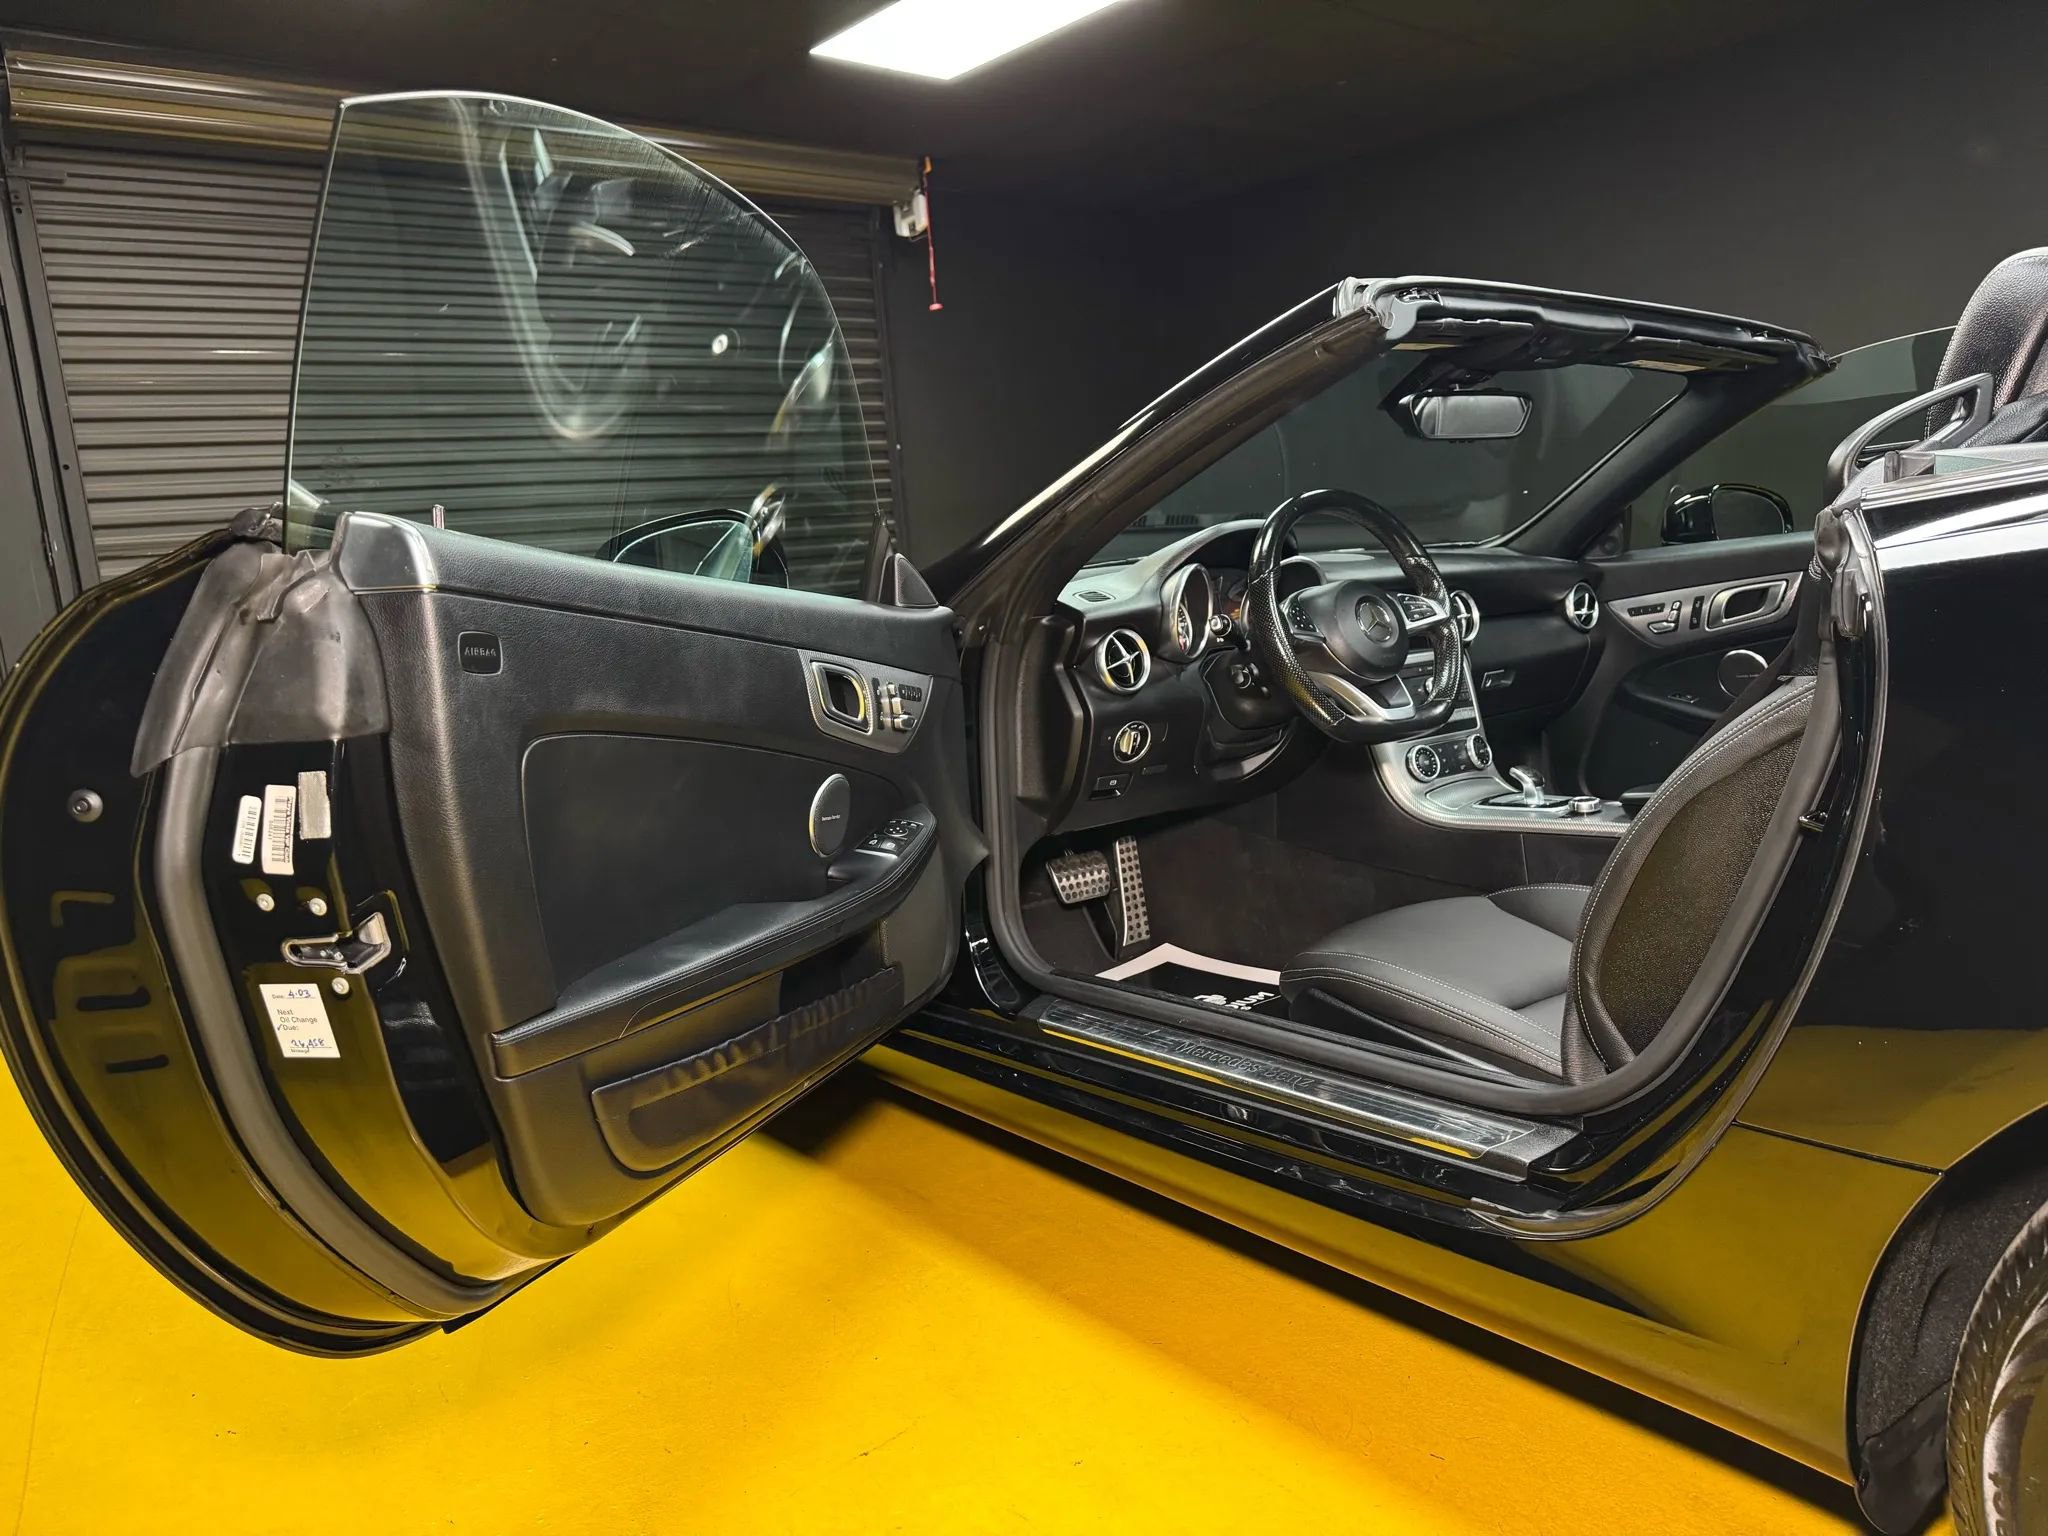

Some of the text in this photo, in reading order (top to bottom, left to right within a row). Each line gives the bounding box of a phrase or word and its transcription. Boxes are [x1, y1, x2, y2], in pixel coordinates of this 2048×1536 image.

[464, 646, 497, 657] AIRBAG
[277, 1008, 294, 1016] Next
[280, 1016, 318, 1025] Oil Change
